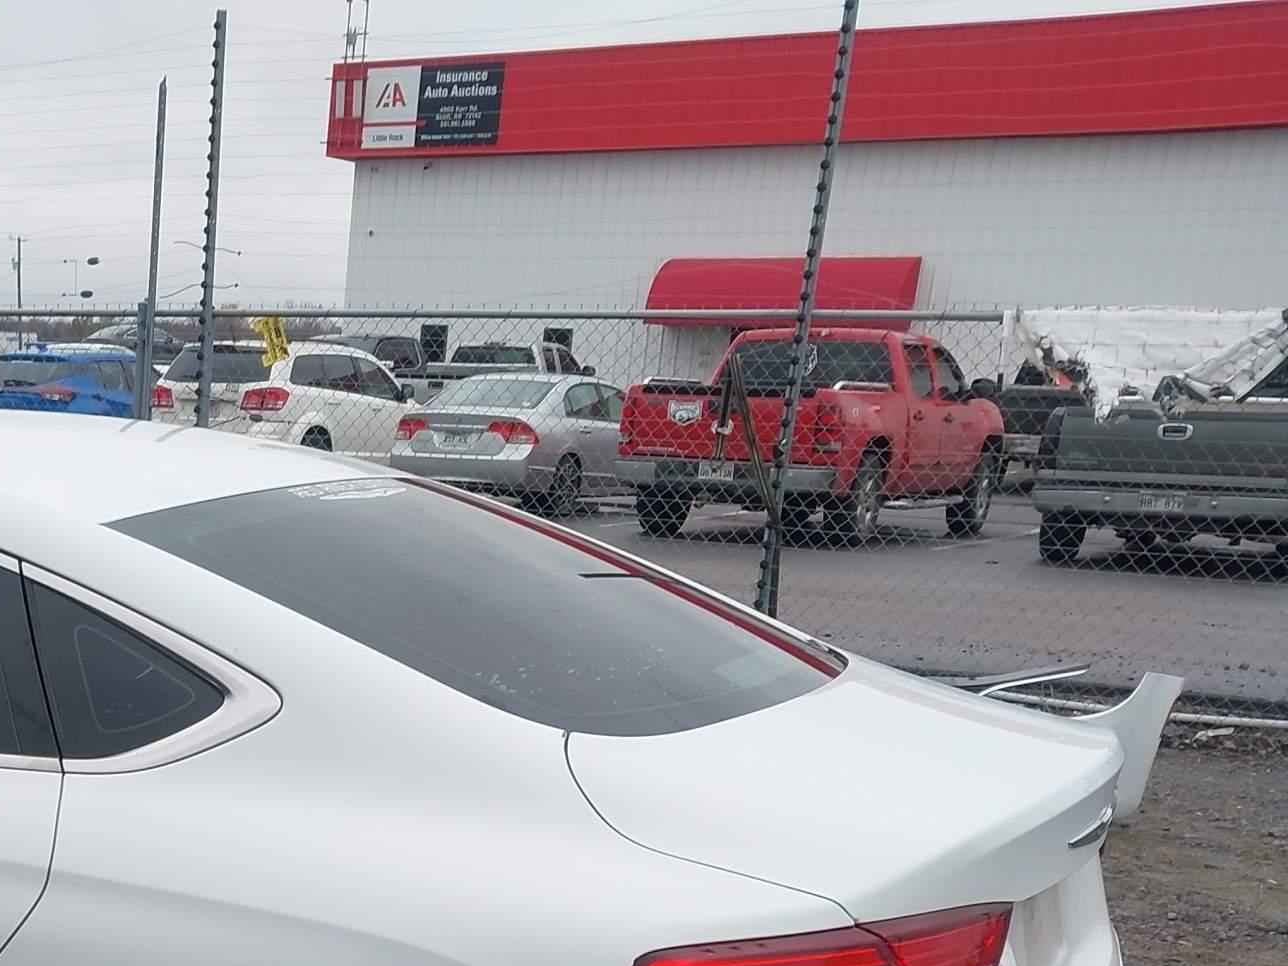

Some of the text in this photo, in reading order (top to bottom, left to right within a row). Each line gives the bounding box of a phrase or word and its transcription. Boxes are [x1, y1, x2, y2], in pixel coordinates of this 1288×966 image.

[436, 69, 489, 84] Insurance
[423, 83, 498, 99] Auto Auctions
[372, 133, 404, 142] Little Rock
